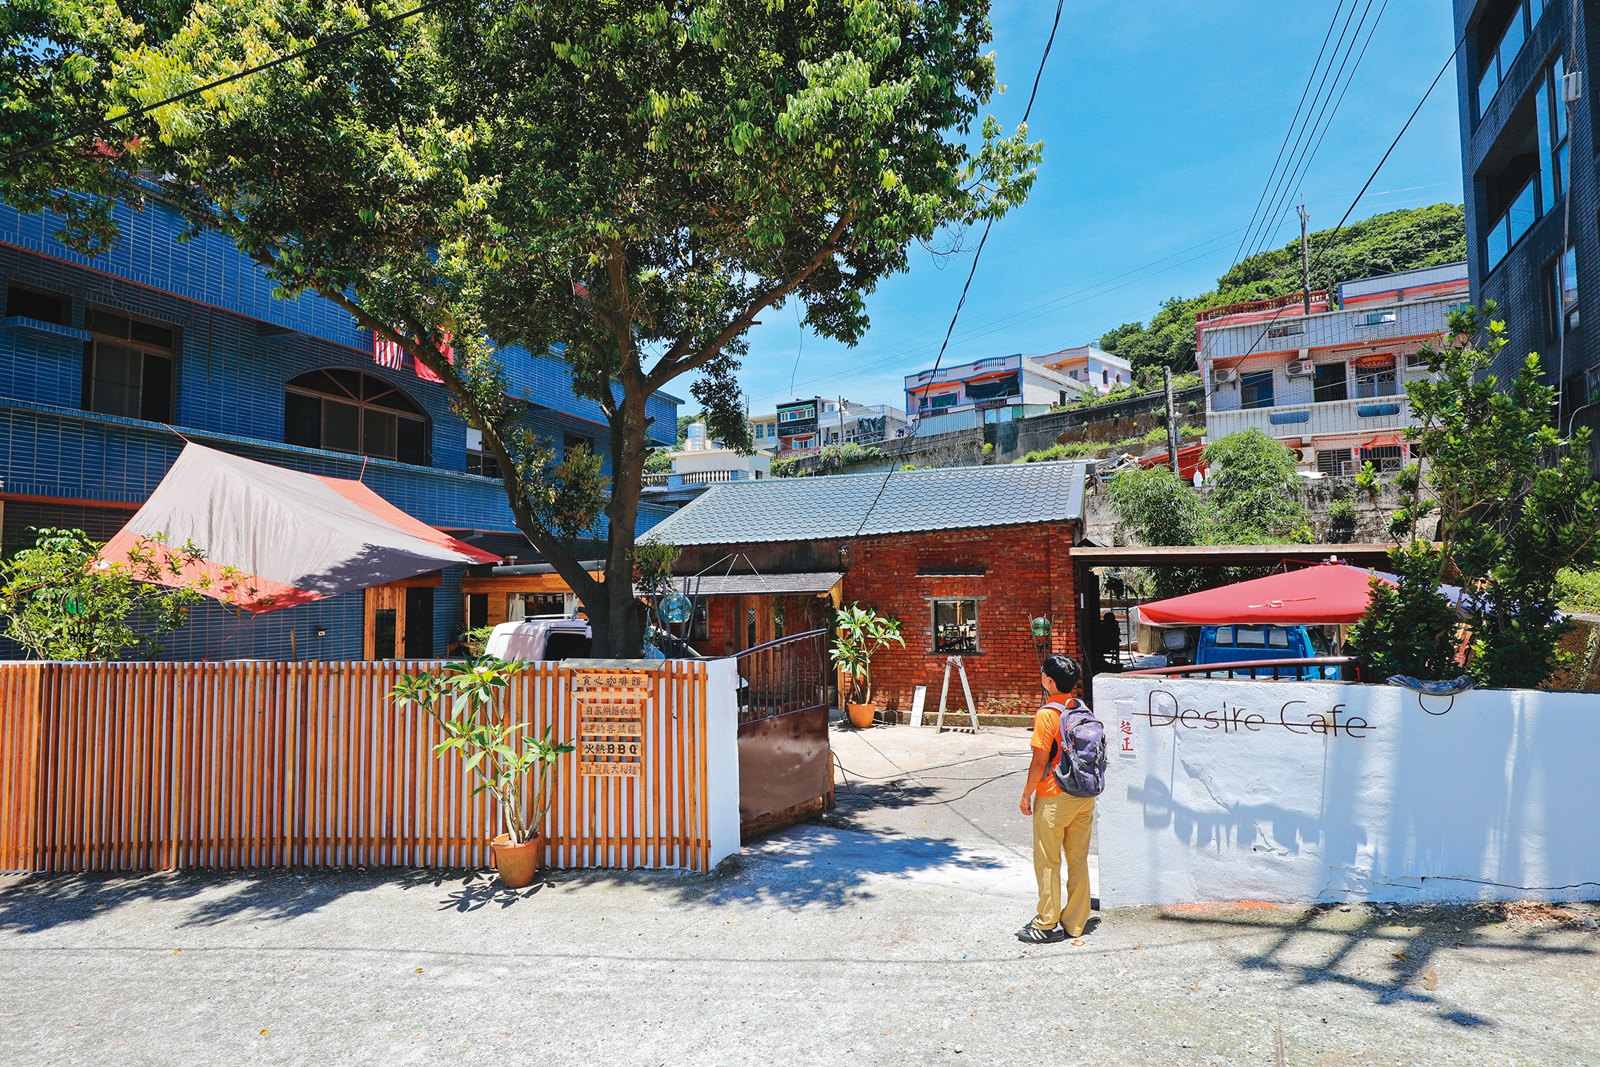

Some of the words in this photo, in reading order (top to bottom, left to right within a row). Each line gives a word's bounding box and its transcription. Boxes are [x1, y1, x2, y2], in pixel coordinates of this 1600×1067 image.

[582, 675, 642, 687] 貪心咖啡館
[1148, 689, 1265, 734] Desire
[1279, 700, 1368, 739] Cafe
